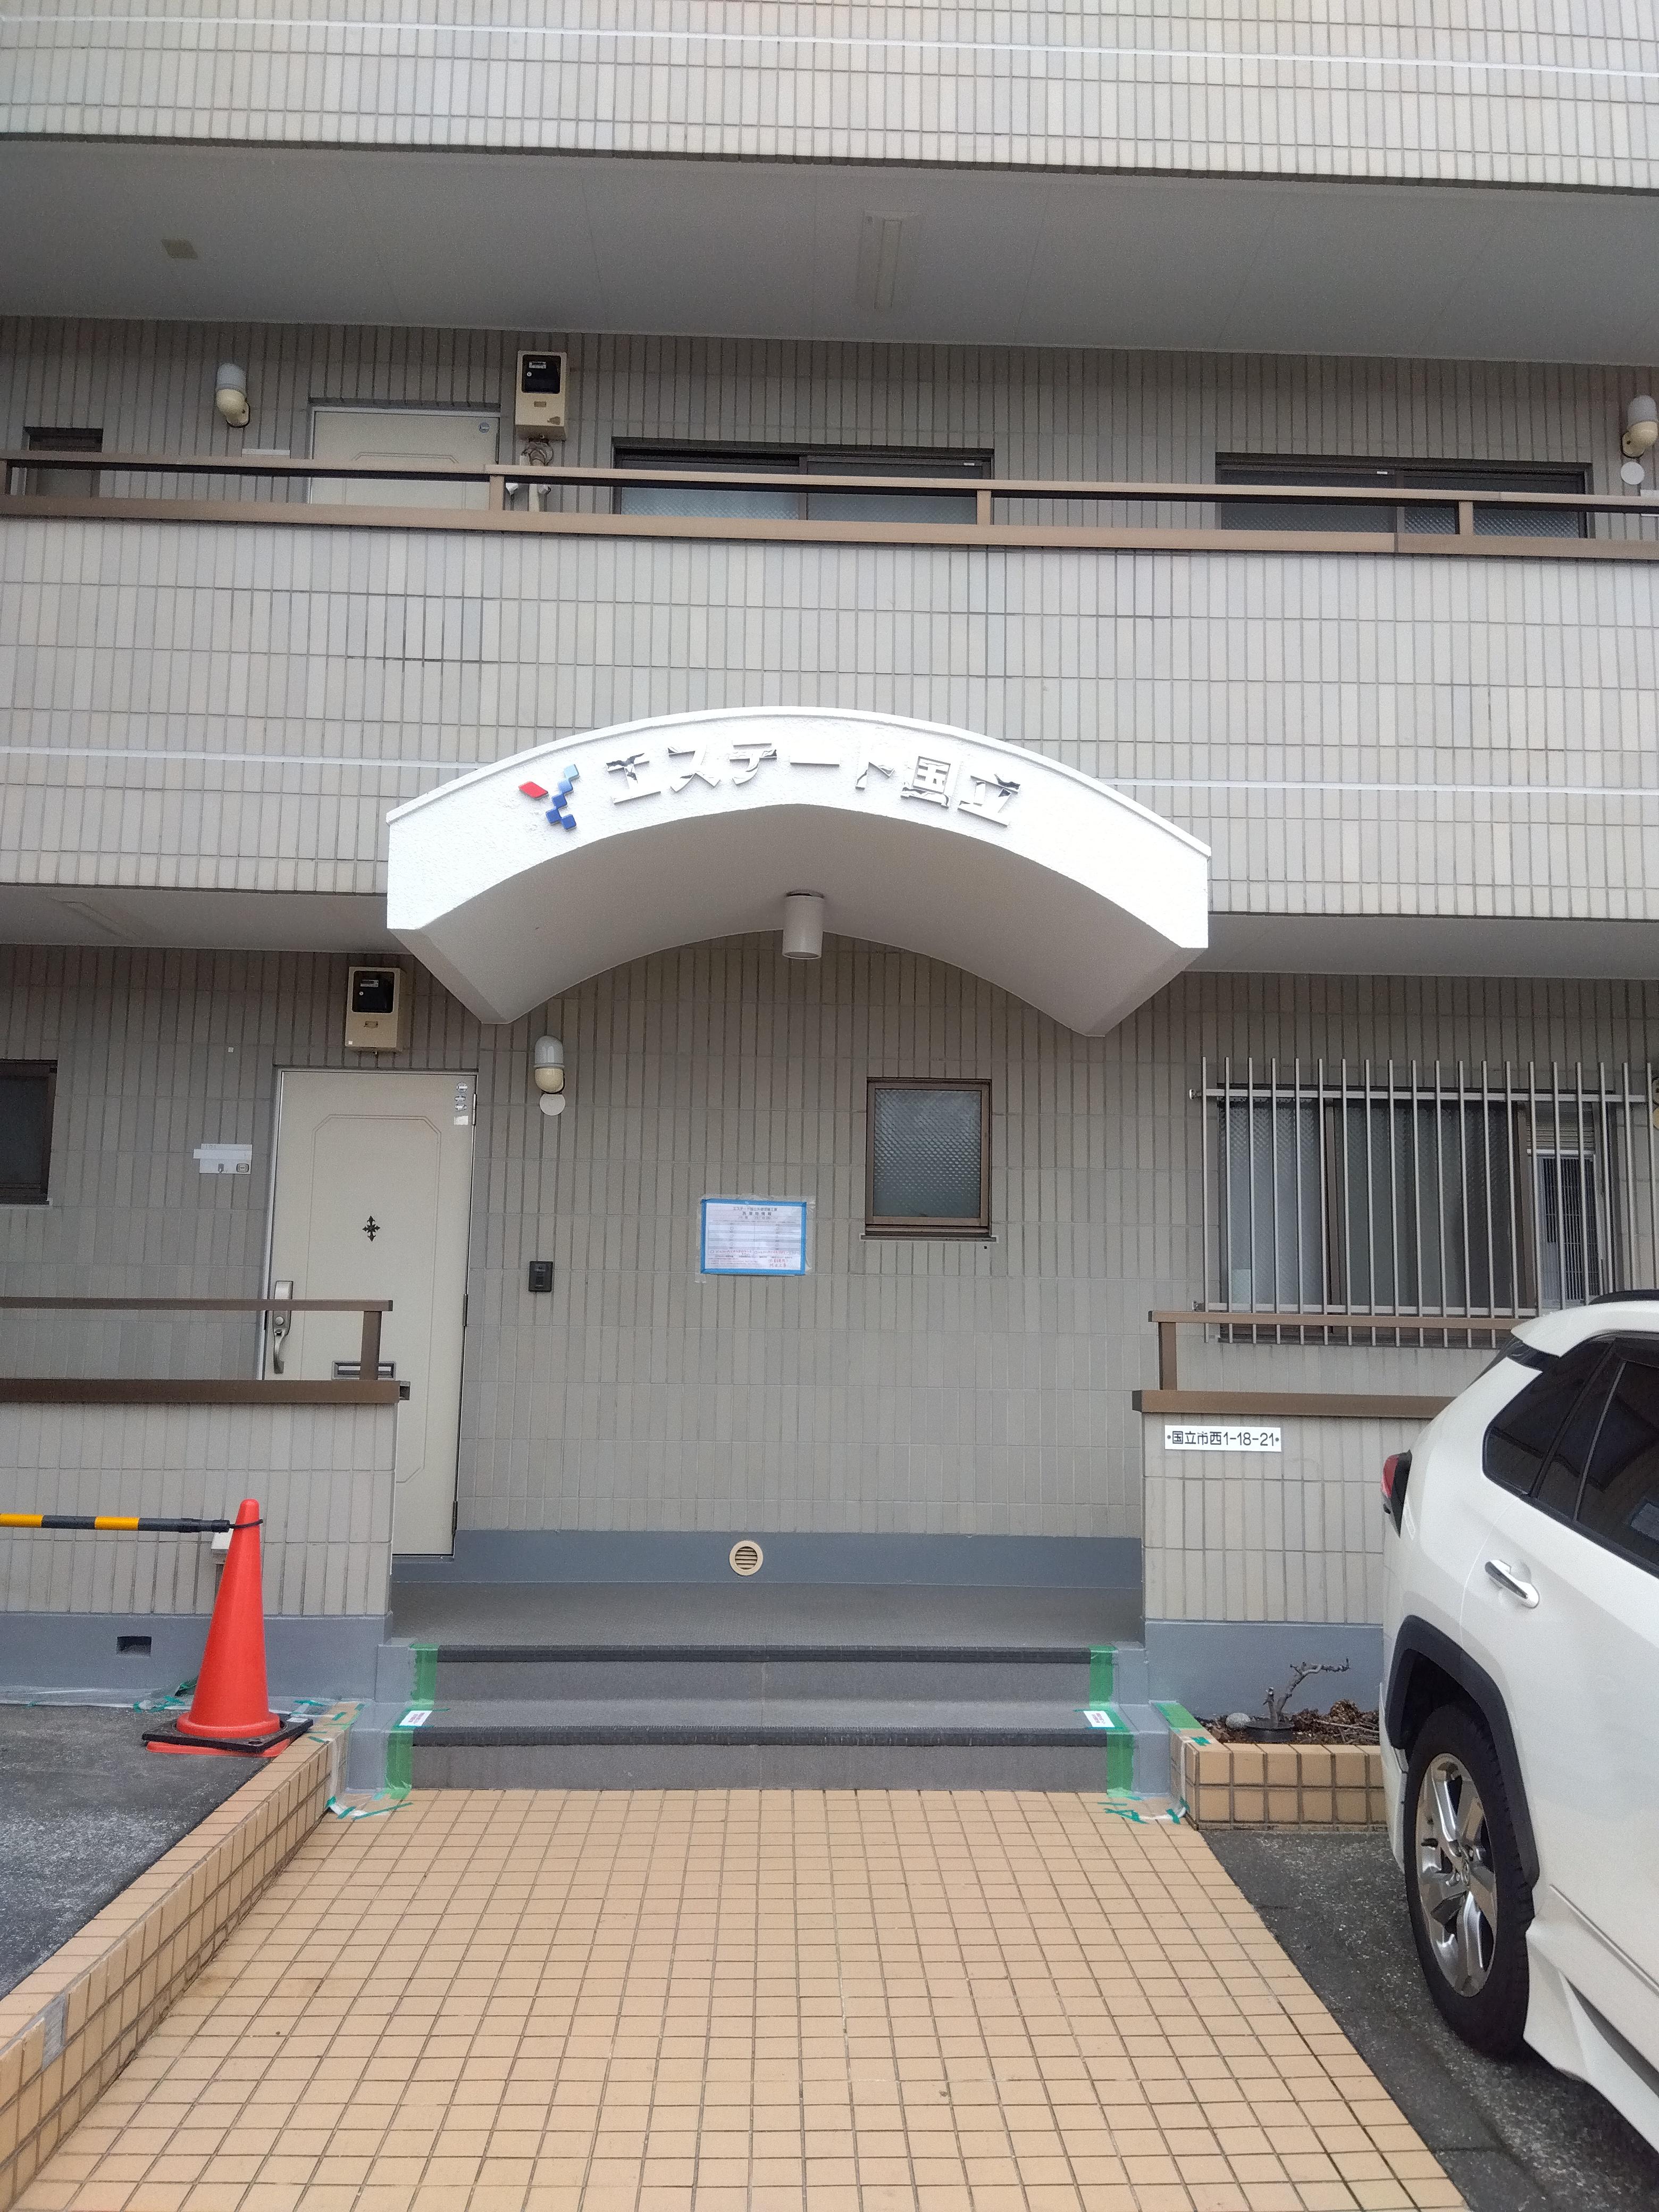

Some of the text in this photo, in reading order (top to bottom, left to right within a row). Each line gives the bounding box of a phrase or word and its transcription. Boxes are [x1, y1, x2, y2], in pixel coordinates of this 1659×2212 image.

[605, 740, 1021, 827] エステート国立
[1172, 1430, 1274, 1446] 国立市西1-18-21
